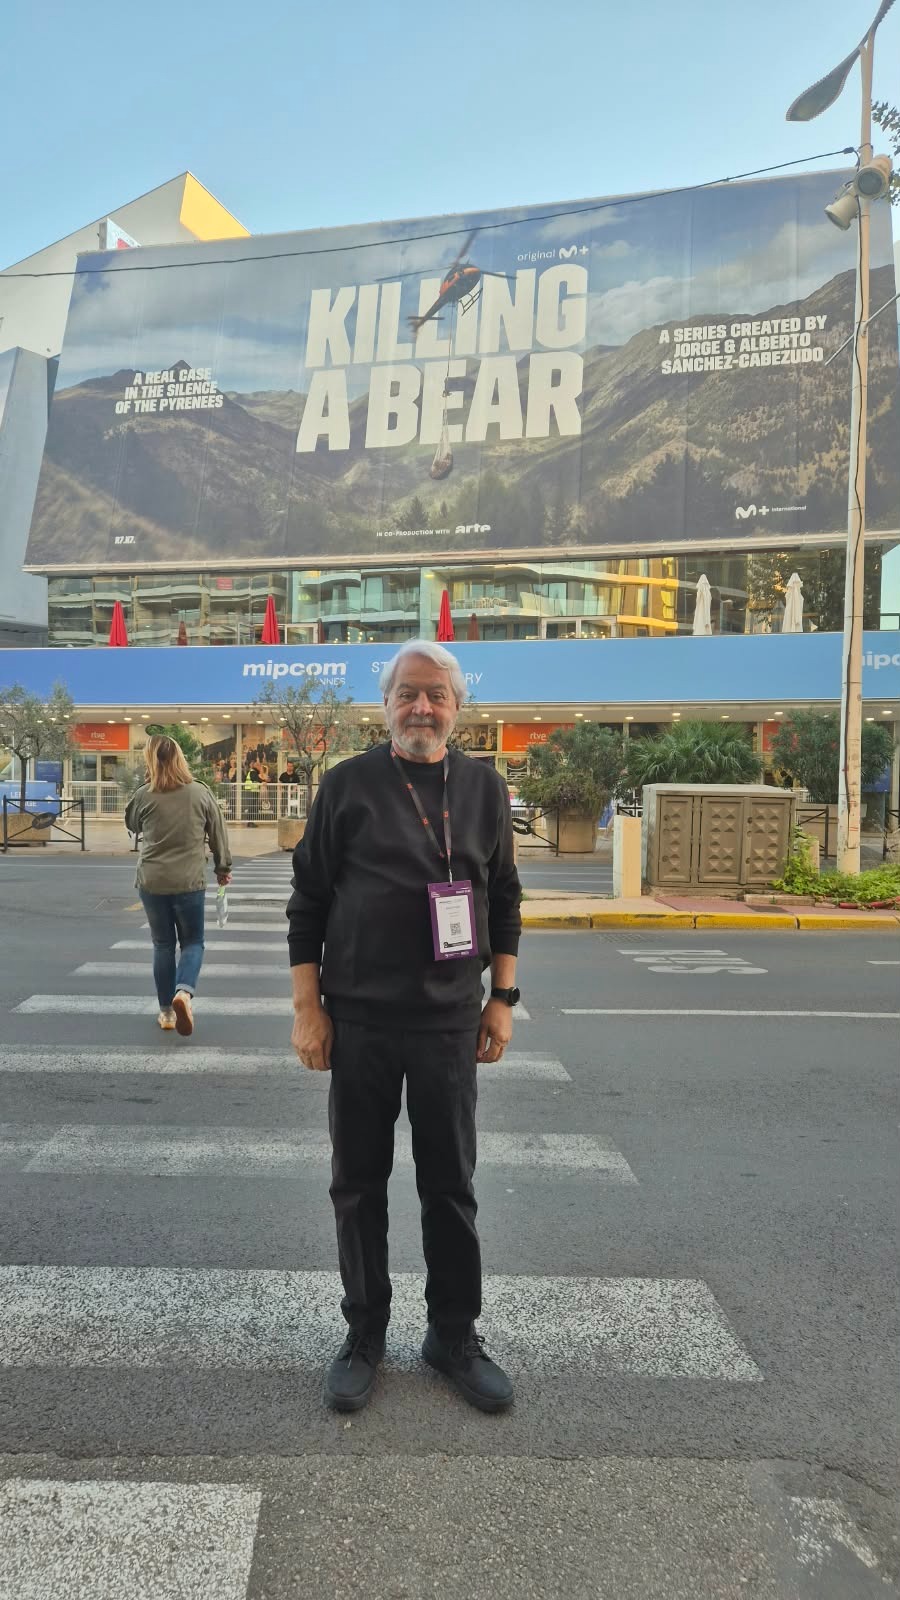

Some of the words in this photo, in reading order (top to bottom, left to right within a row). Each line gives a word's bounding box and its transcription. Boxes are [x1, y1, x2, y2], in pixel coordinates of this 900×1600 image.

[517, 249, 556, 262] original
[304, 263, 588, 368] KILLING
[659, 330, 669, 344] A
[673, 324, 726, 343] SERIES
[730, 317, 801, 338] CREATED
[805, 315, 828, 331] BY
[674, 340, 720, 358] JORGE
[724, 339, 736, 354] &
[739, 332, 811, 352] ALBERTO
[133, 372, 142, 385] A
[145, 370, 176, 385] REAL
[179, 368, 212, 382] CASE
[125, 386, 138, 400] IN
[141, 385, 164, 399] THE
[166, 381, 218, 397] SILENCE
[115, 401, 131, 414] OF
[134, 399, 157, 413] THE
[159, 395, 224, 412] PYRENEES
[296, 369, 351, 453] A
[364, 351, 584, 449] BEAR
[455, 523, 491, 534] arte
[243, 659, 347, 680] mipcom
[530, 732, 548, 741] rtve
